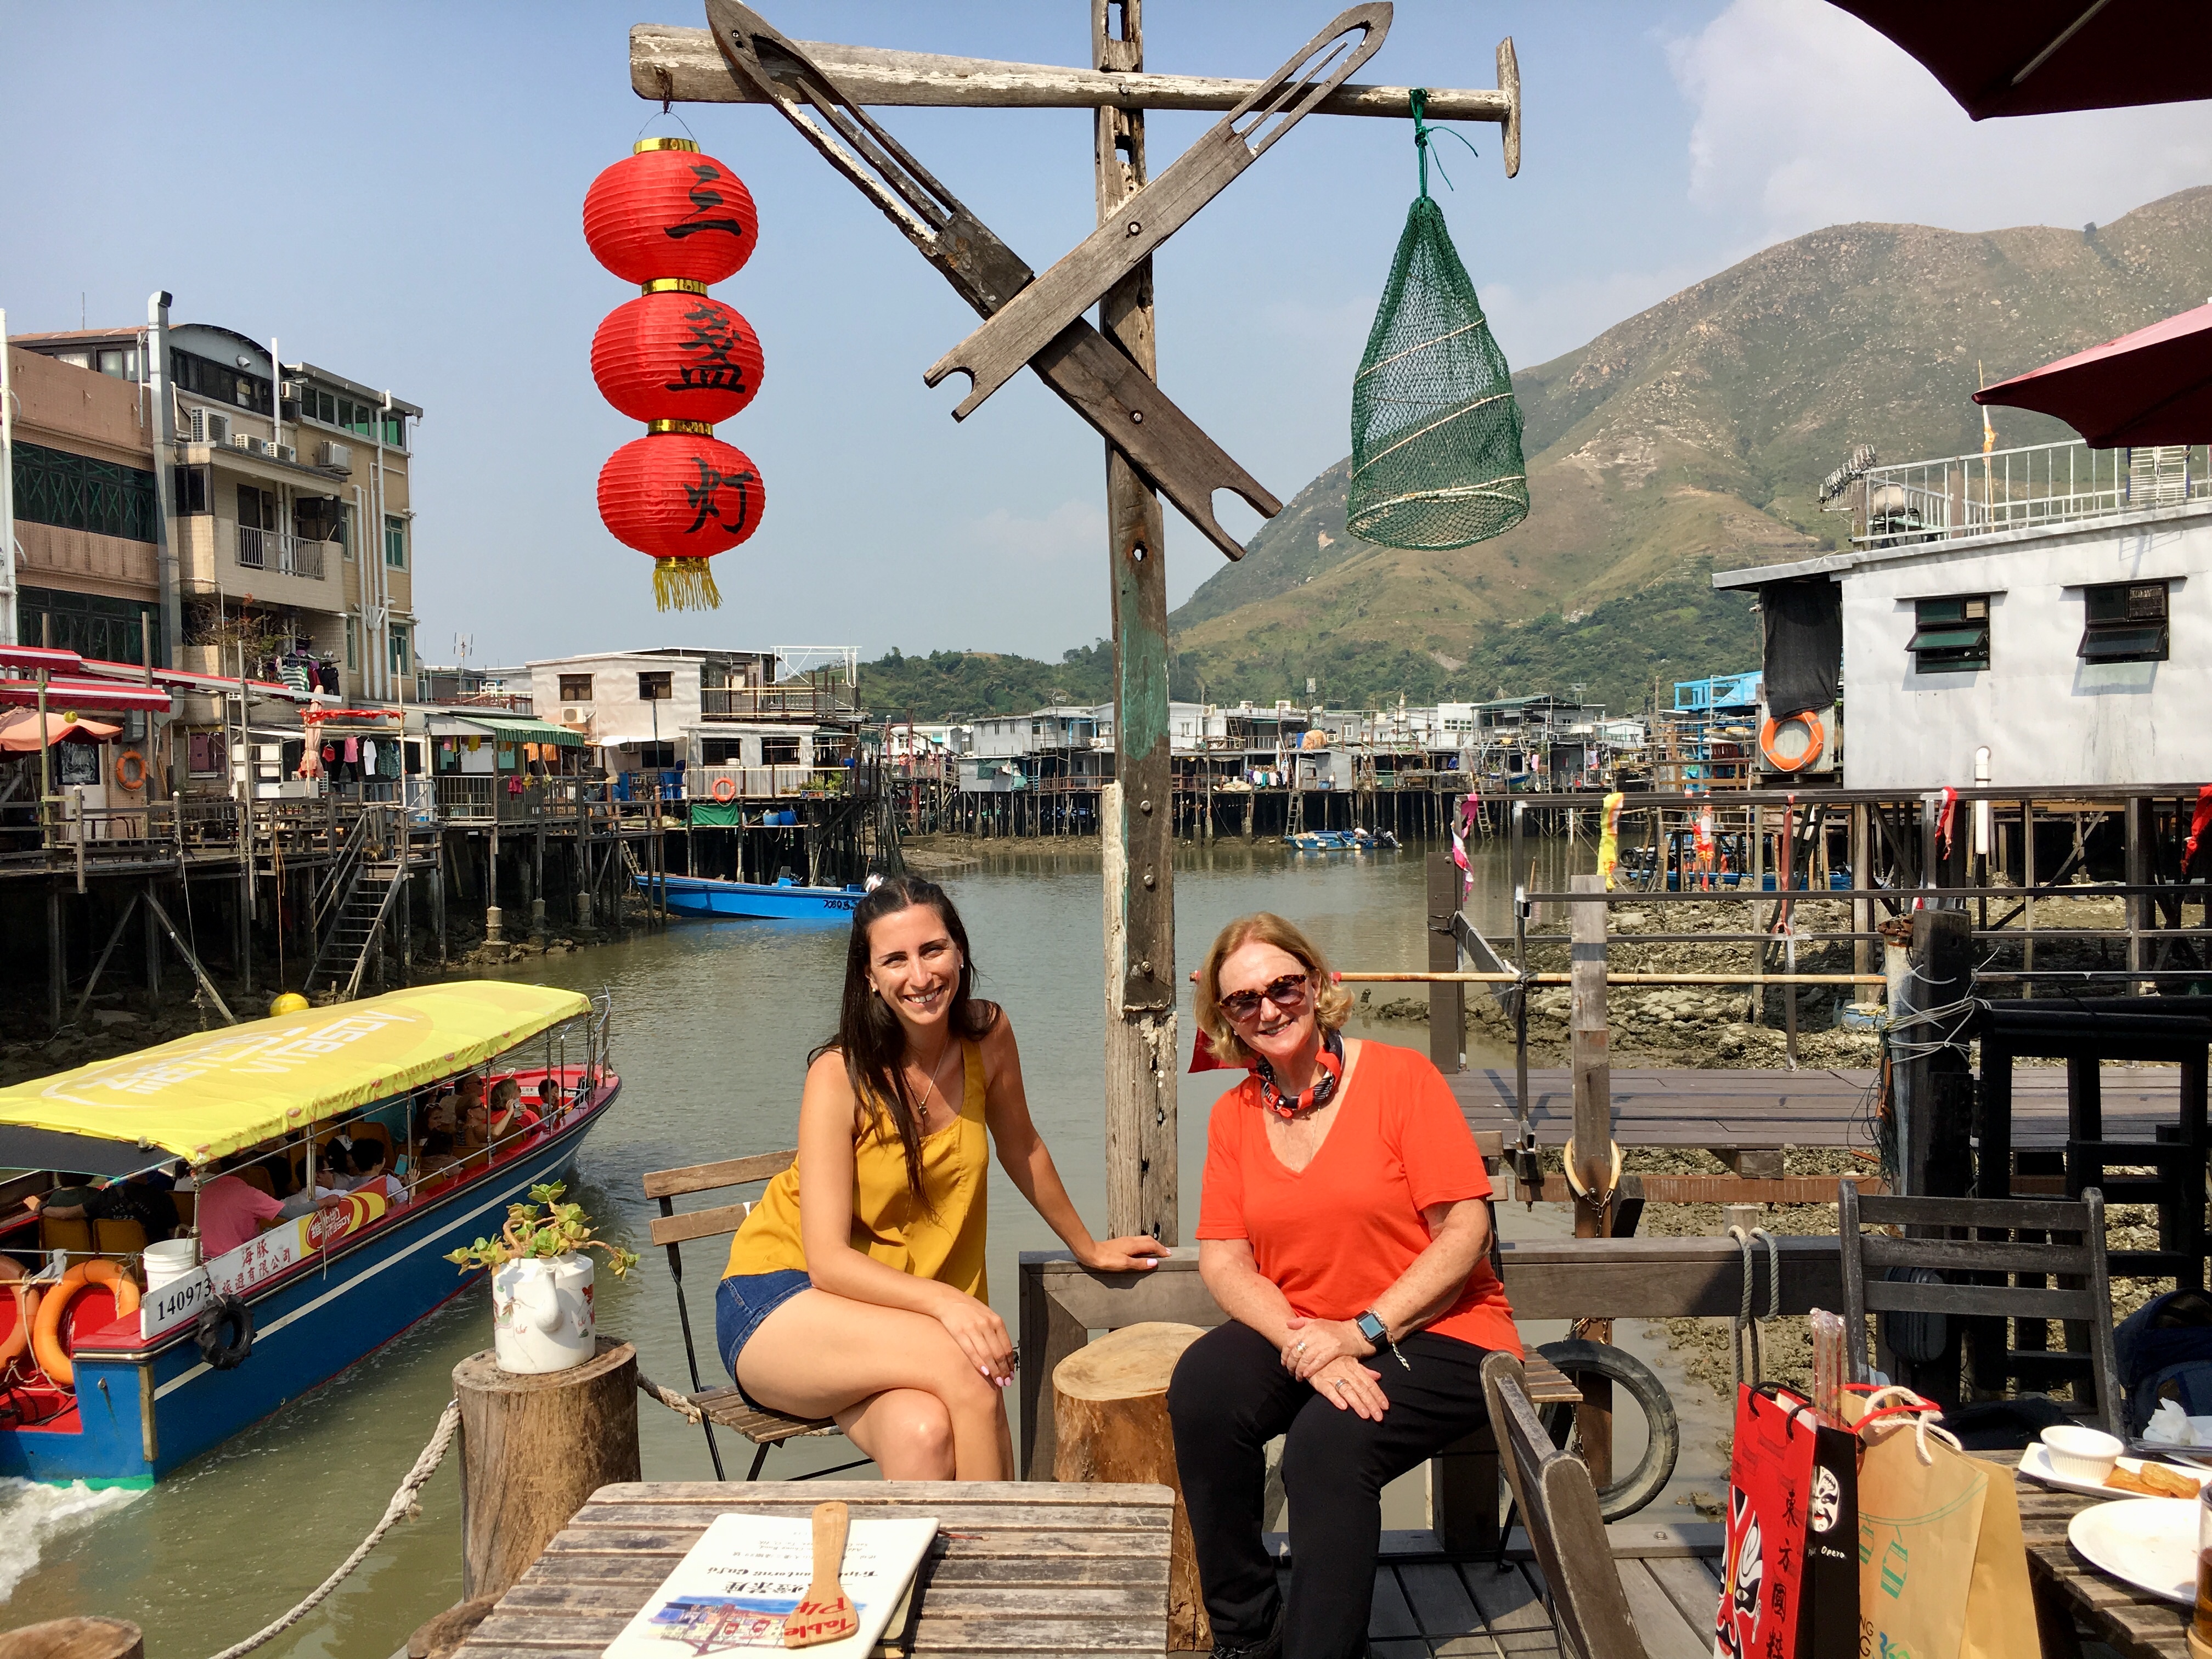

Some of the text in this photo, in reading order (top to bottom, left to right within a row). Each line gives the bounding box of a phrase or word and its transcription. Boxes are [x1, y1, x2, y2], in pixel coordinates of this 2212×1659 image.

[241, 1238, 269, 1267] 海豚
[158, 1277, 212, 1321] 140973
[1821, 1545, 1847, 1559] Opera
[794, 1596, 848, 1616] P4
[784, 1618, 856, 1639] Table
